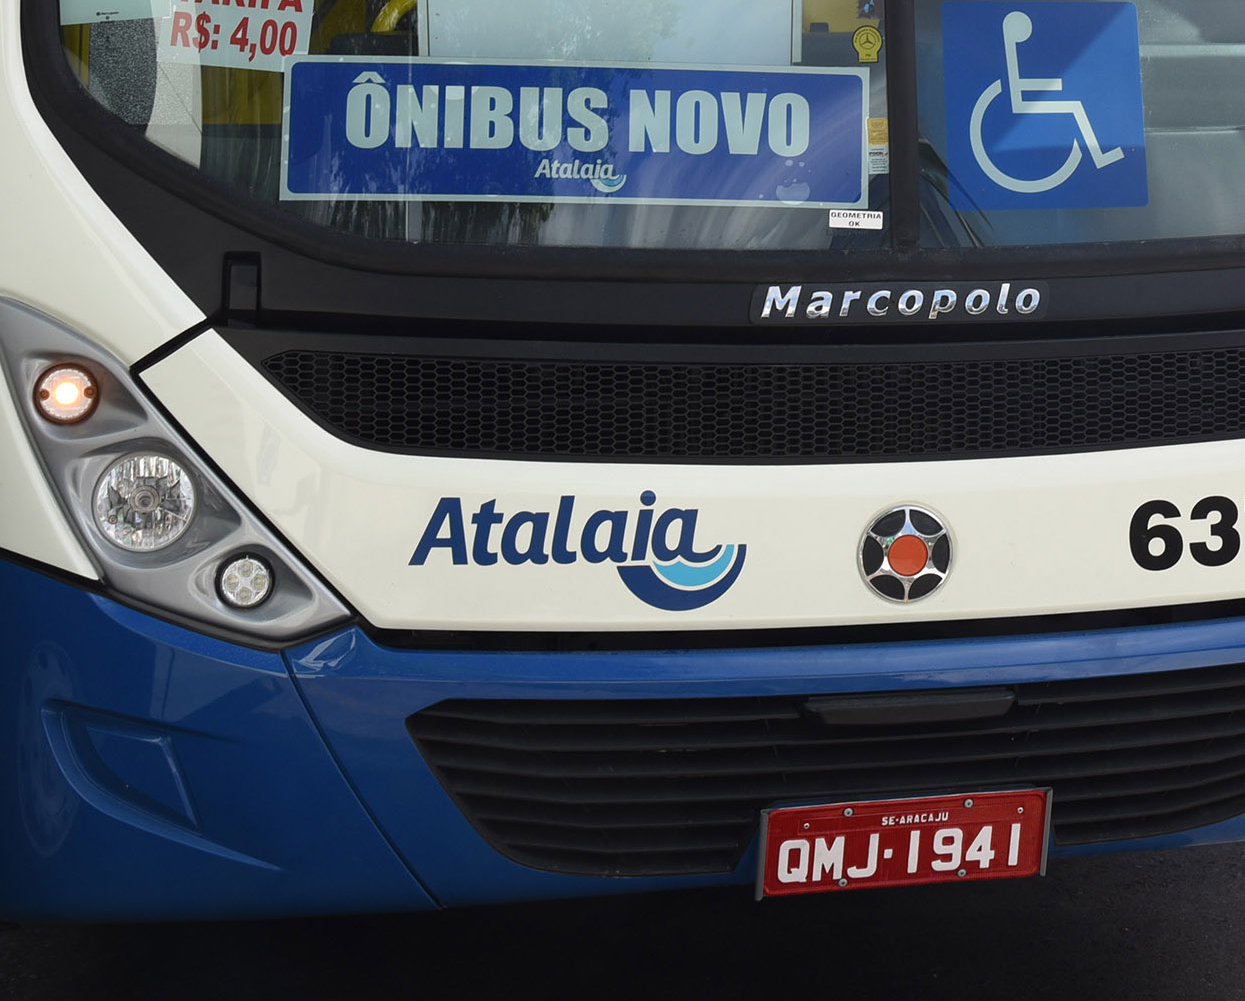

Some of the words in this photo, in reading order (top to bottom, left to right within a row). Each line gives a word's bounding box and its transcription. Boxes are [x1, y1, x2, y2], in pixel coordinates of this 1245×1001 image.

[170, 11, 221, 54] R$:
[229, 17, 298, 63] 4,00
[345, 71, 609, 153] ÔNIBUS
[628, 89, 811, 158] NOVO
[533, 158, 624, 184] Atalaia
[830, 211, 882, 220] GEOMETRIA
[760, 282, 1042, 320] Marcopolo
[407, 489, 730, 576] Atalaia
